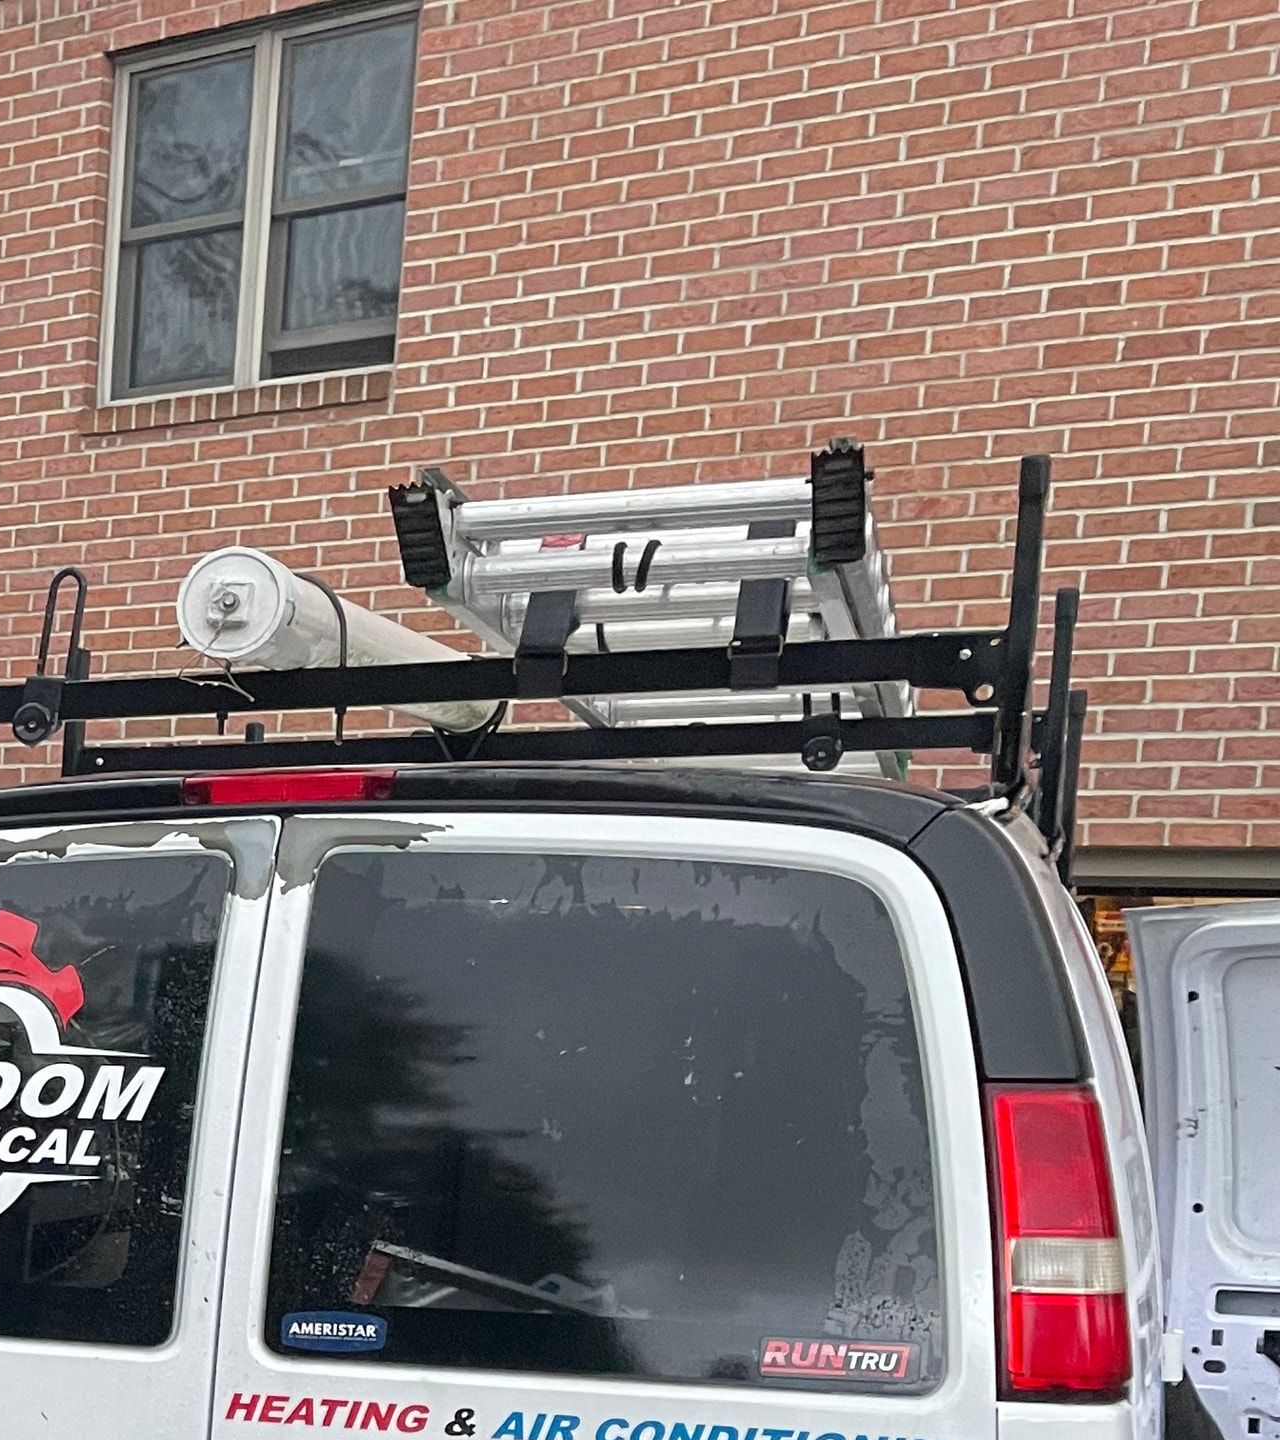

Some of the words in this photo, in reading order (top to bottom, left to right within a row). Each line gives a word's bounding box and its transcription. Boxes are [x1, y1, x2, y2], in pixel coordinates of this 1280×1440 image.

[289, 1322, 377, 1338] AMERISTAR
[225, 1393, 430, 1433] HEATING
[444, 1407, 477, 1437] &
